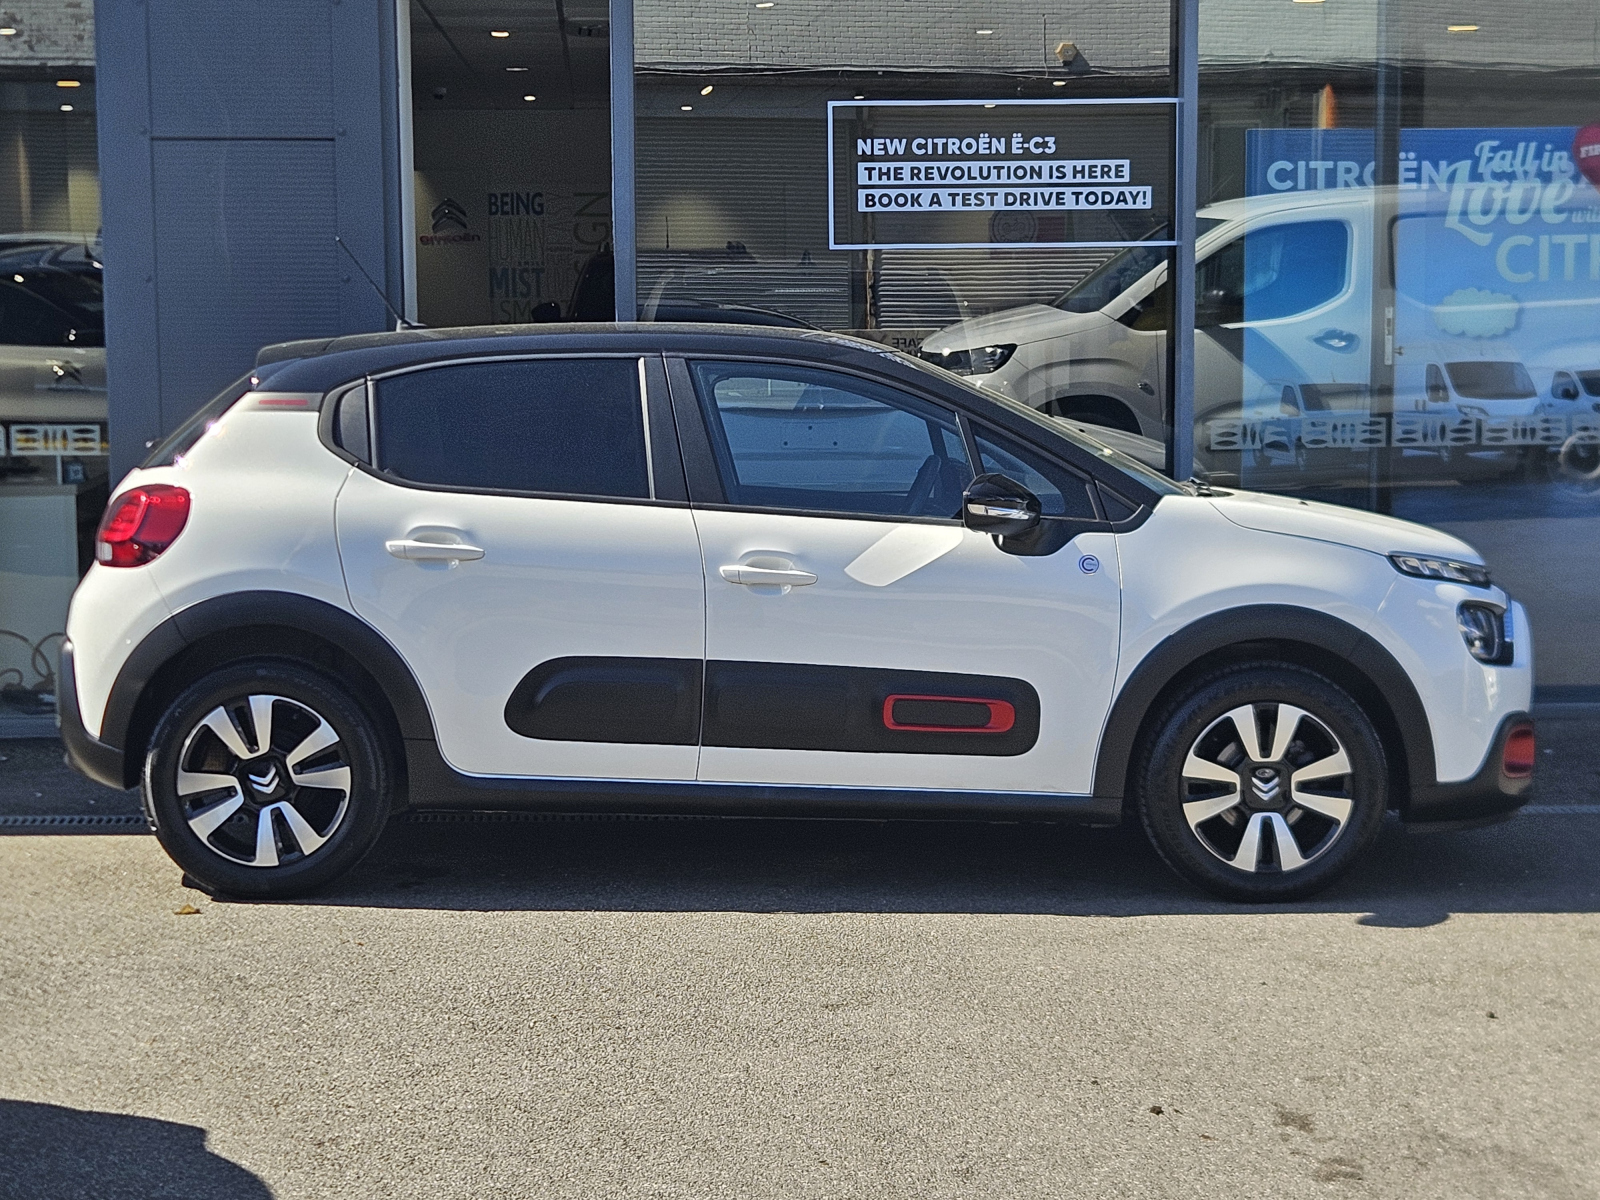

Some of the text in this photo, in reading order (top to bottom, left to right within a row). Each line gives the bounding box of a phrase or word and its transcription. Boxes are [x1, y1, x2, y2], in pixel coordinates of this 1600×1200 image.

[857, 132, 1057, 155] NEW CITROËN Ë-C3
[1474, 141, 1569, 173] Fall in
[864, 164, 1125, 182] THE REVOLUTION IS HERE
[488, 192, 545, 216] BEING
[864, 190, 1148, 208] BOOK A TEST DRIVE TODAY!
[1445, 160, 1576, 247] Love
[488, 267, 546, 298] MIST
